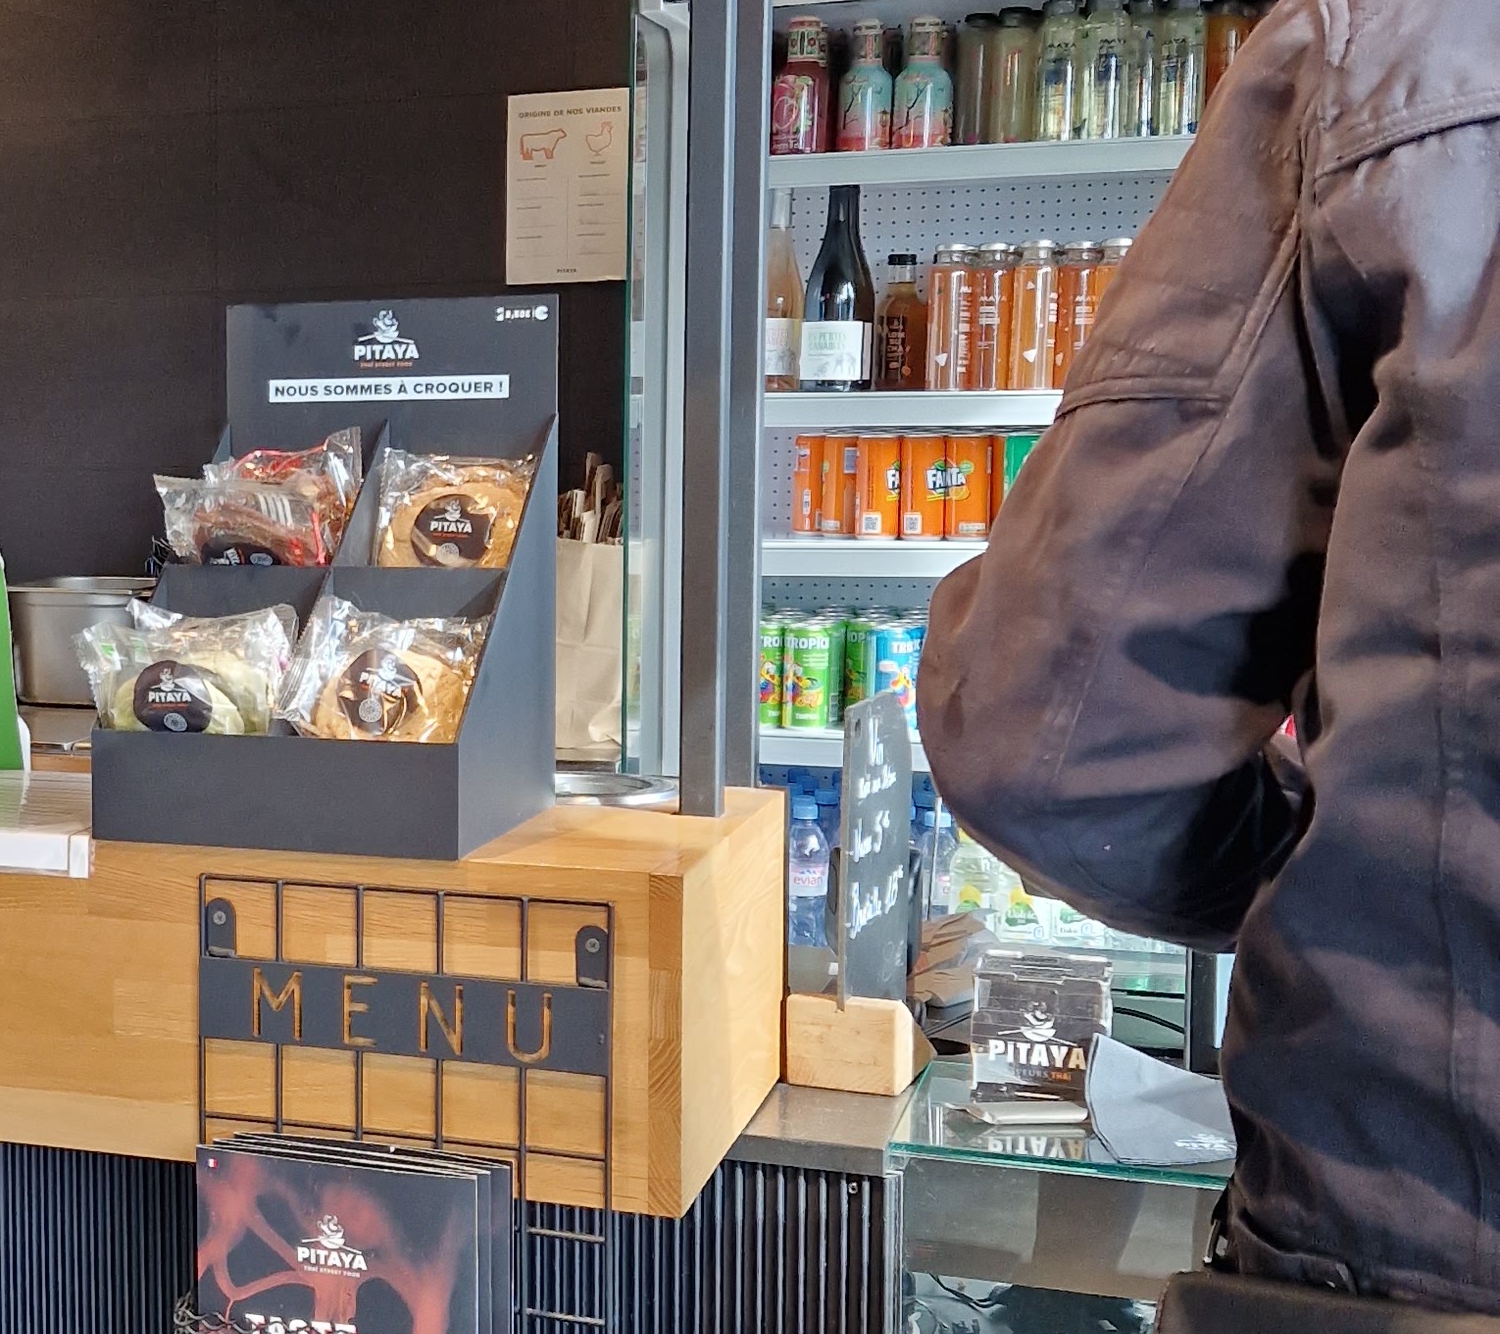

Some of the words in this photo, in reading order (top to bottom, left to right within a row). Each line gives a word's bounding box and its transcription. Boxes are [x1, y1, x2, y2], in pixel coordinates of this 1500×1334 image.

[553, 109, 564, 117] DE
[566, 107, 584, 116] NOS
[586, 105, 622, 115] VIANDES
[353, 343, 420, 361] PITAYA
[274, 385, 319, 397] NOUS
[323, 383, 392, 396] SOMMES
[397, 380, 408, 394] À
[413, 381, 493, 395] CROQUER
[429, 520, 473, 534] PITAYA
[148, 691, 192, 703] PITAYA
[793, 876, 823, 885] evian
[252, 967, 552, 1064] MENU
[988, 1039, 1087, 1070] PITAYA
[296, 1245, 368, 1271] PITAYA
